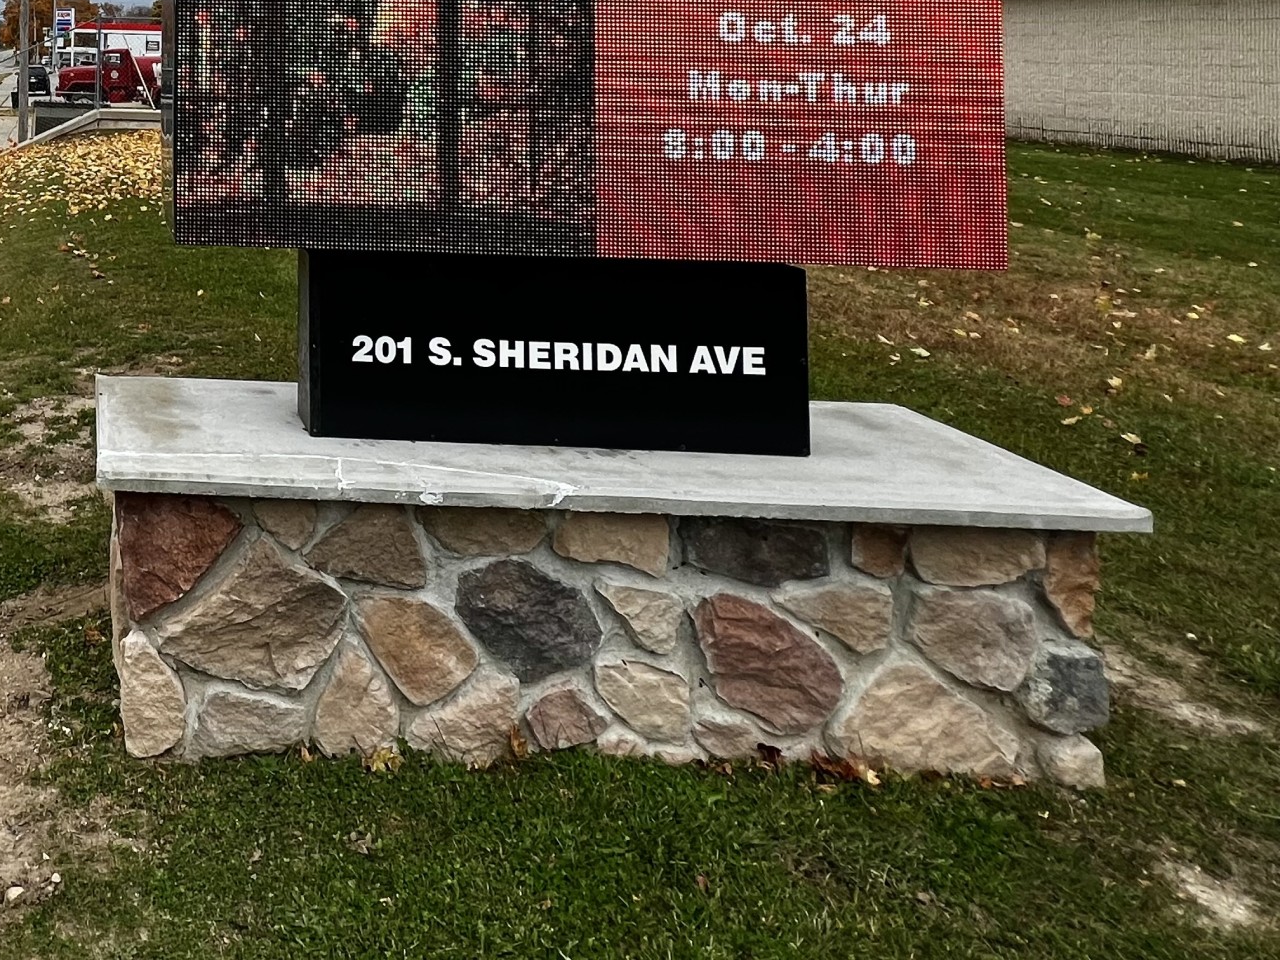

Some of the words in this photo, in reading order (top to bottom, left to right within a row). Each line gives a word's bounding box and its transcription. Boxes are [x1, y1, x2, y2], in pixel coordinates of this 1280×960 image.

[719, 11, 811, 44] Oct.
[832, 14, 891, 46] 24
[663, 128, 765, 161] 8:00
[809, 132, 916, 164] 4:00
[352, 335, 412, 364] 201
[428, 337, 462, 367] S.
[472, 338, 678, 374] SHERIDAN
[688, 346, 766, 376] AVE
